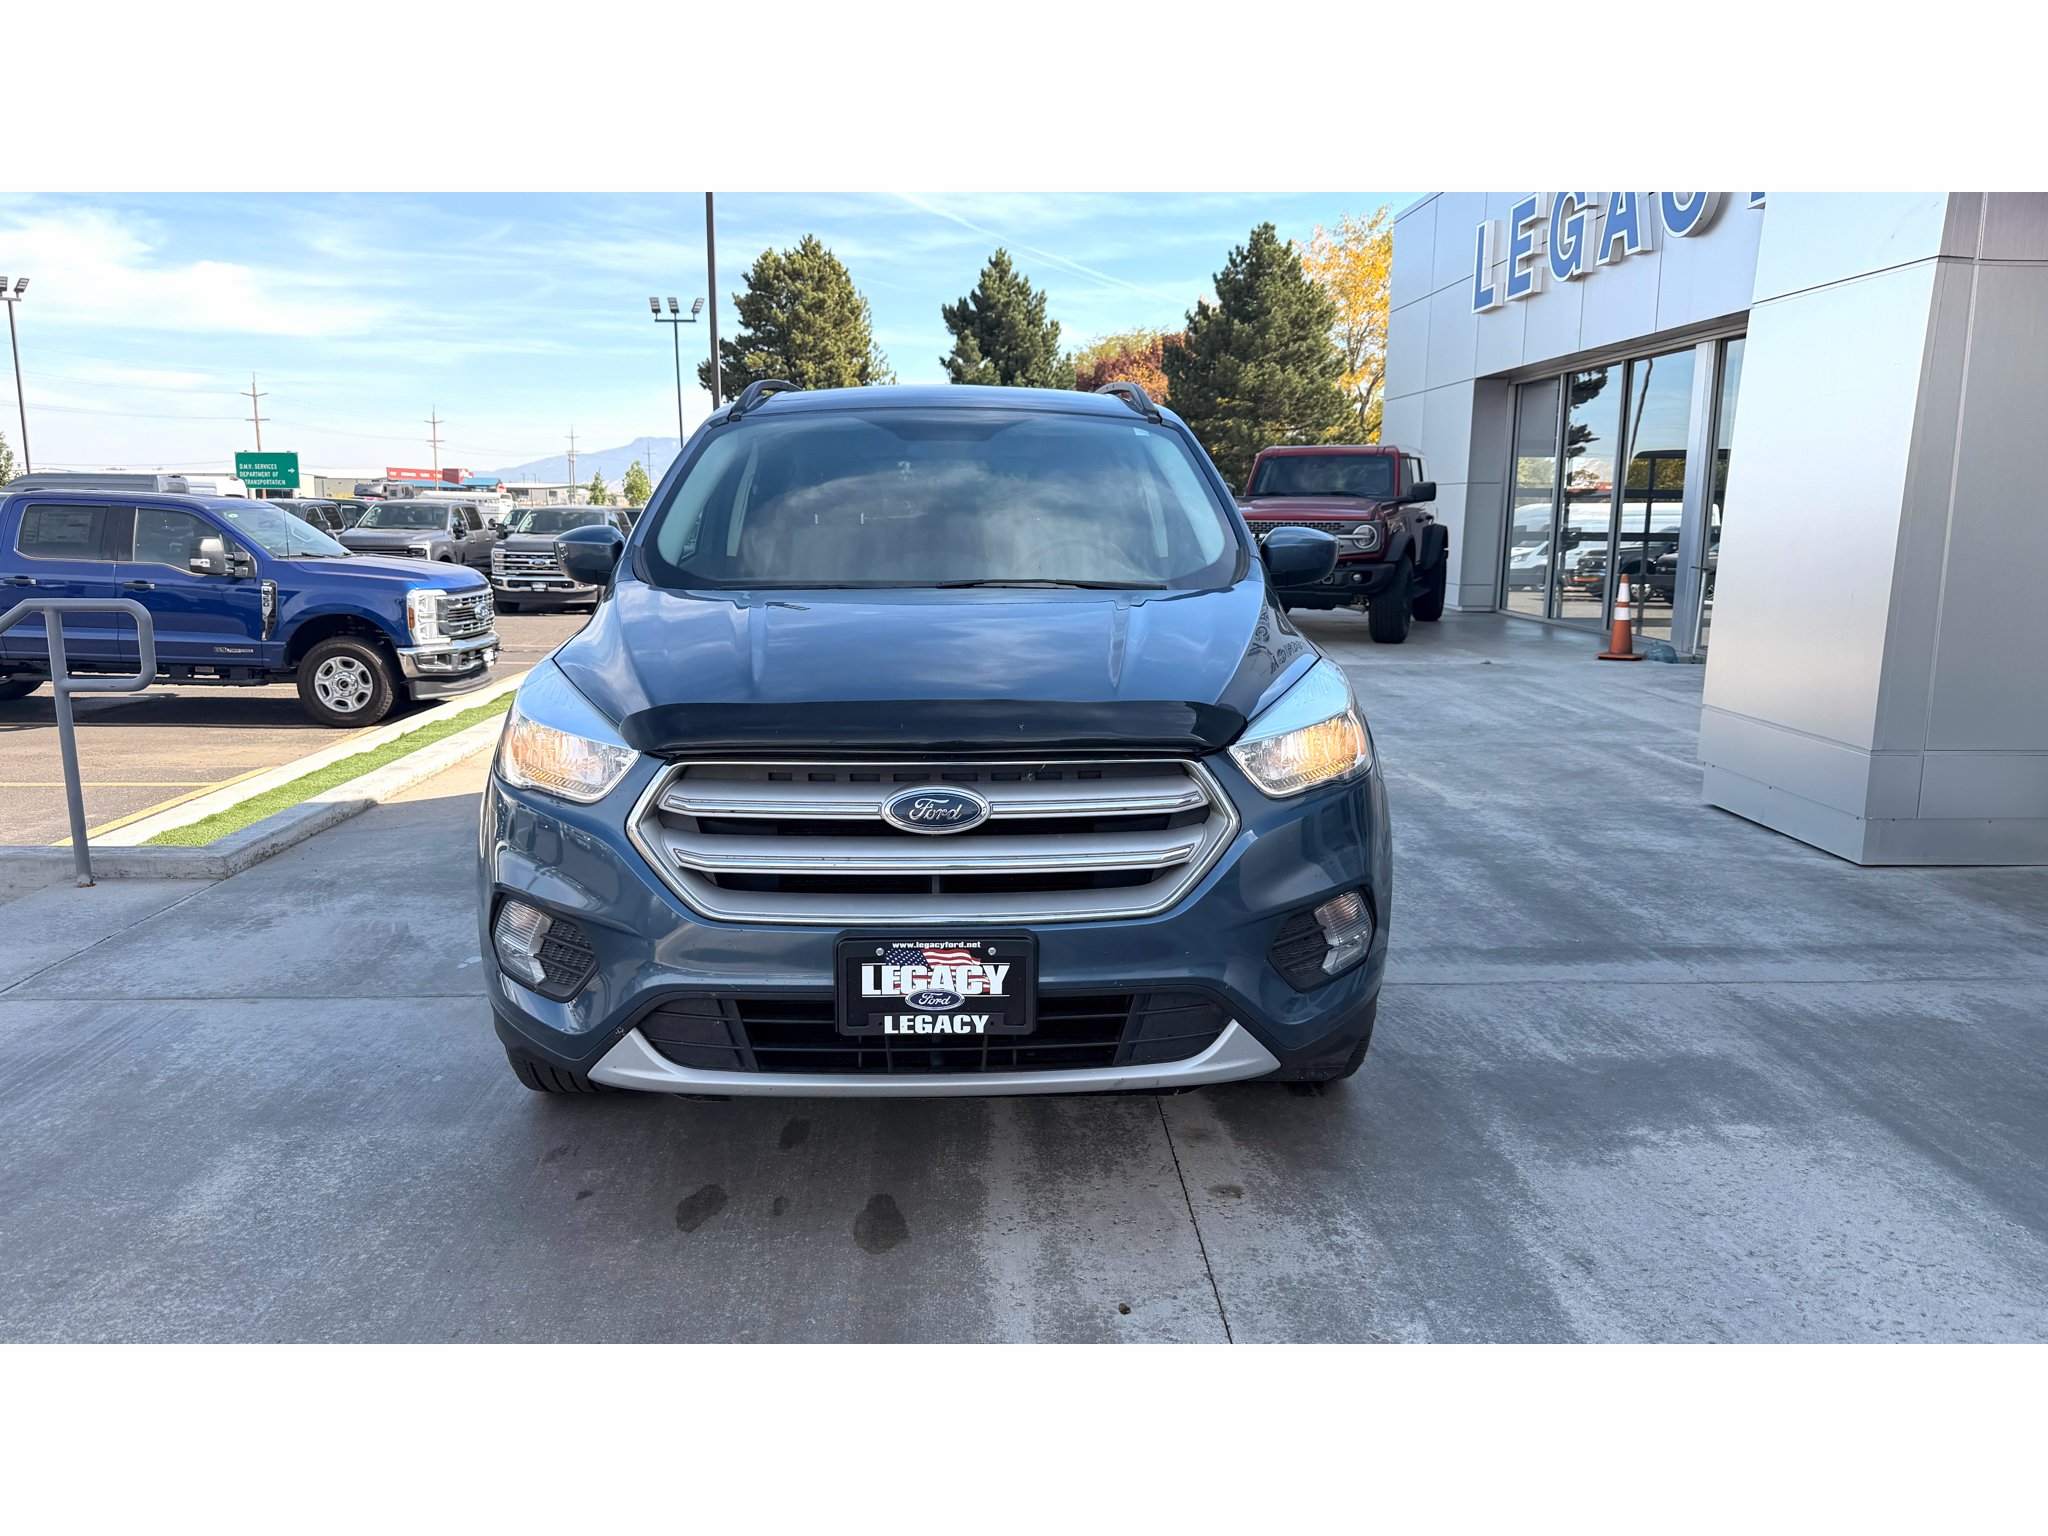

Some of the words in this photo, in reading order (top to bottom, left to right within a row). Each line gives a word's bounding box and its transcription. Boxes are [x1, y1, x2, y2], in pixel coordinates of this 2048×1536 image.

[1471, 191, 1766, 314] LEGA
[908, 798, 963, 821] Ford
[892, 941, 981, 949] www.legacyford.net
[861, 965, 1010, 996] LEGACY
[918, 992, 951, 1006] Ford
[884, 1014, 989, 1035] LEGACY
